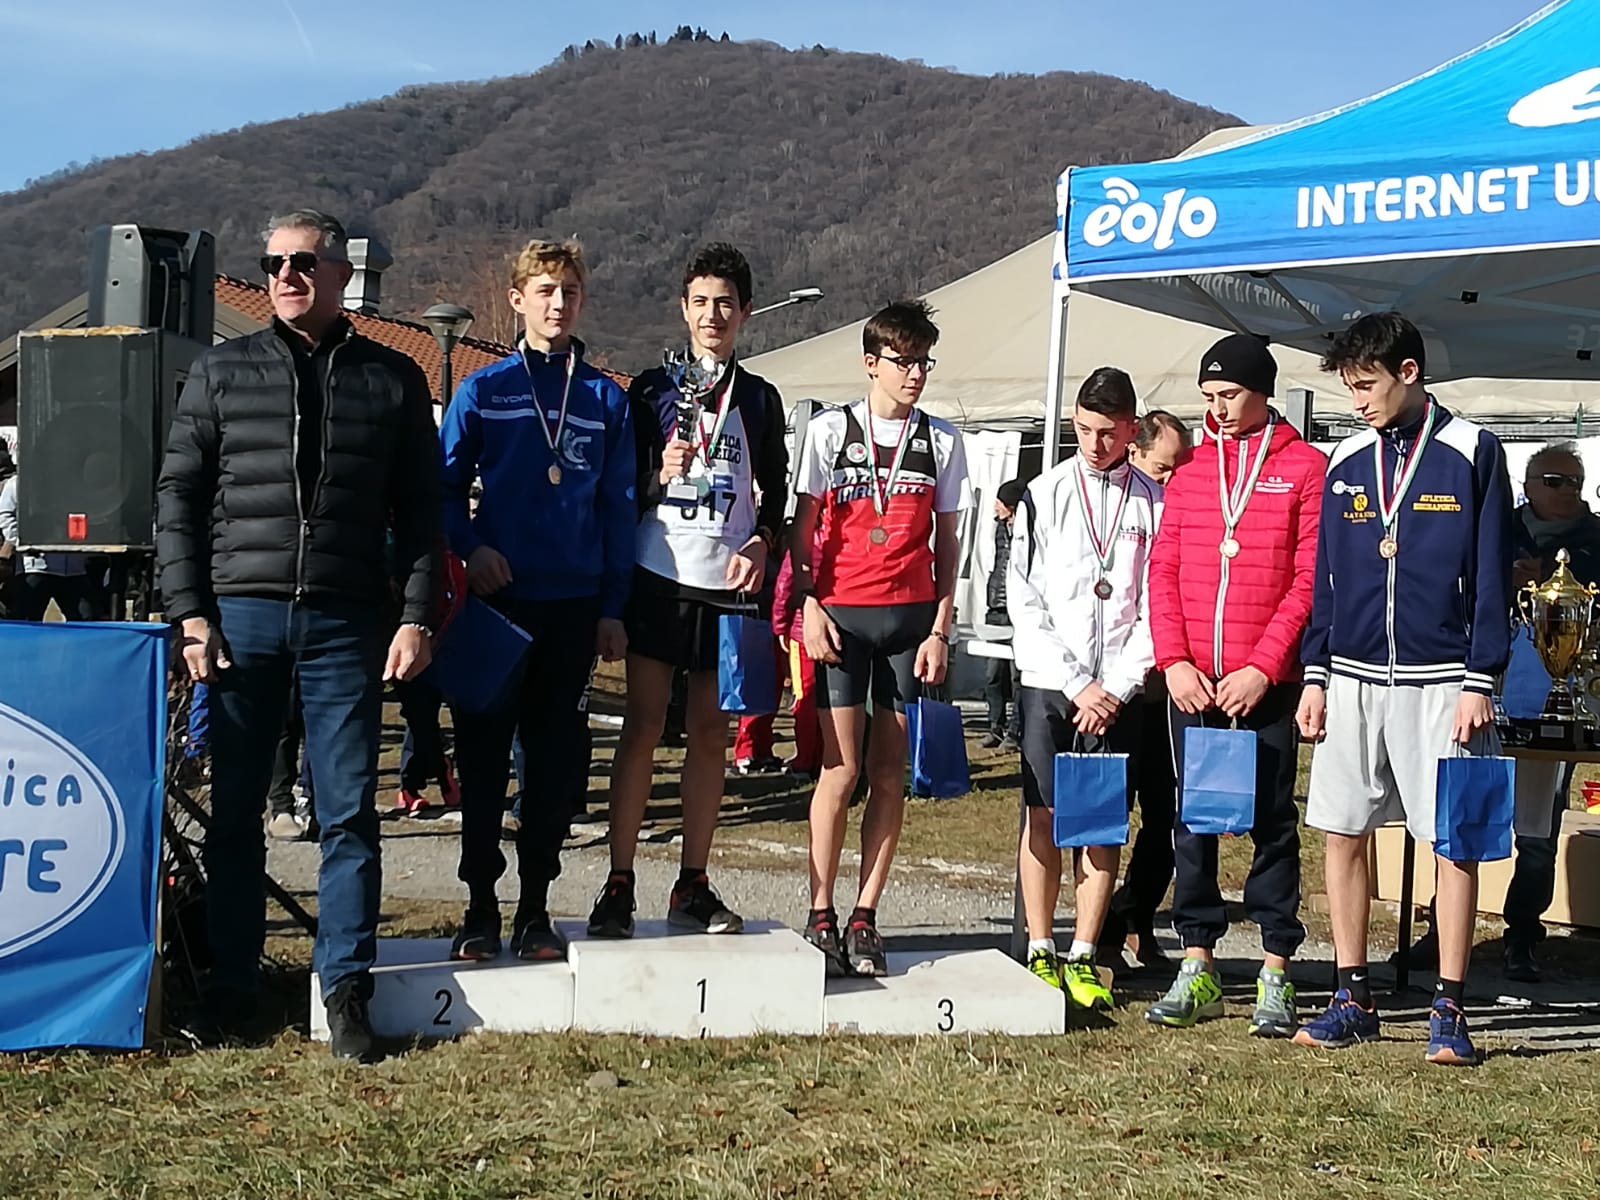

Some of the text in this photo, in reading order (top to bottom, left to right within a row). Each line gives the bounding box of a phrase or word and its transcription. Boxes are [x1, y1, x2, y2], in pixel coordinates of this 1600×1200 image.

[1296, 165, 1539, 229] INTERNET
[1083, 188, 1217, 250] eolo
[433, 988, 453, 1026] 2
[696, 978, 707, 1014] 1
[937, 998, 955, 1032] 3
